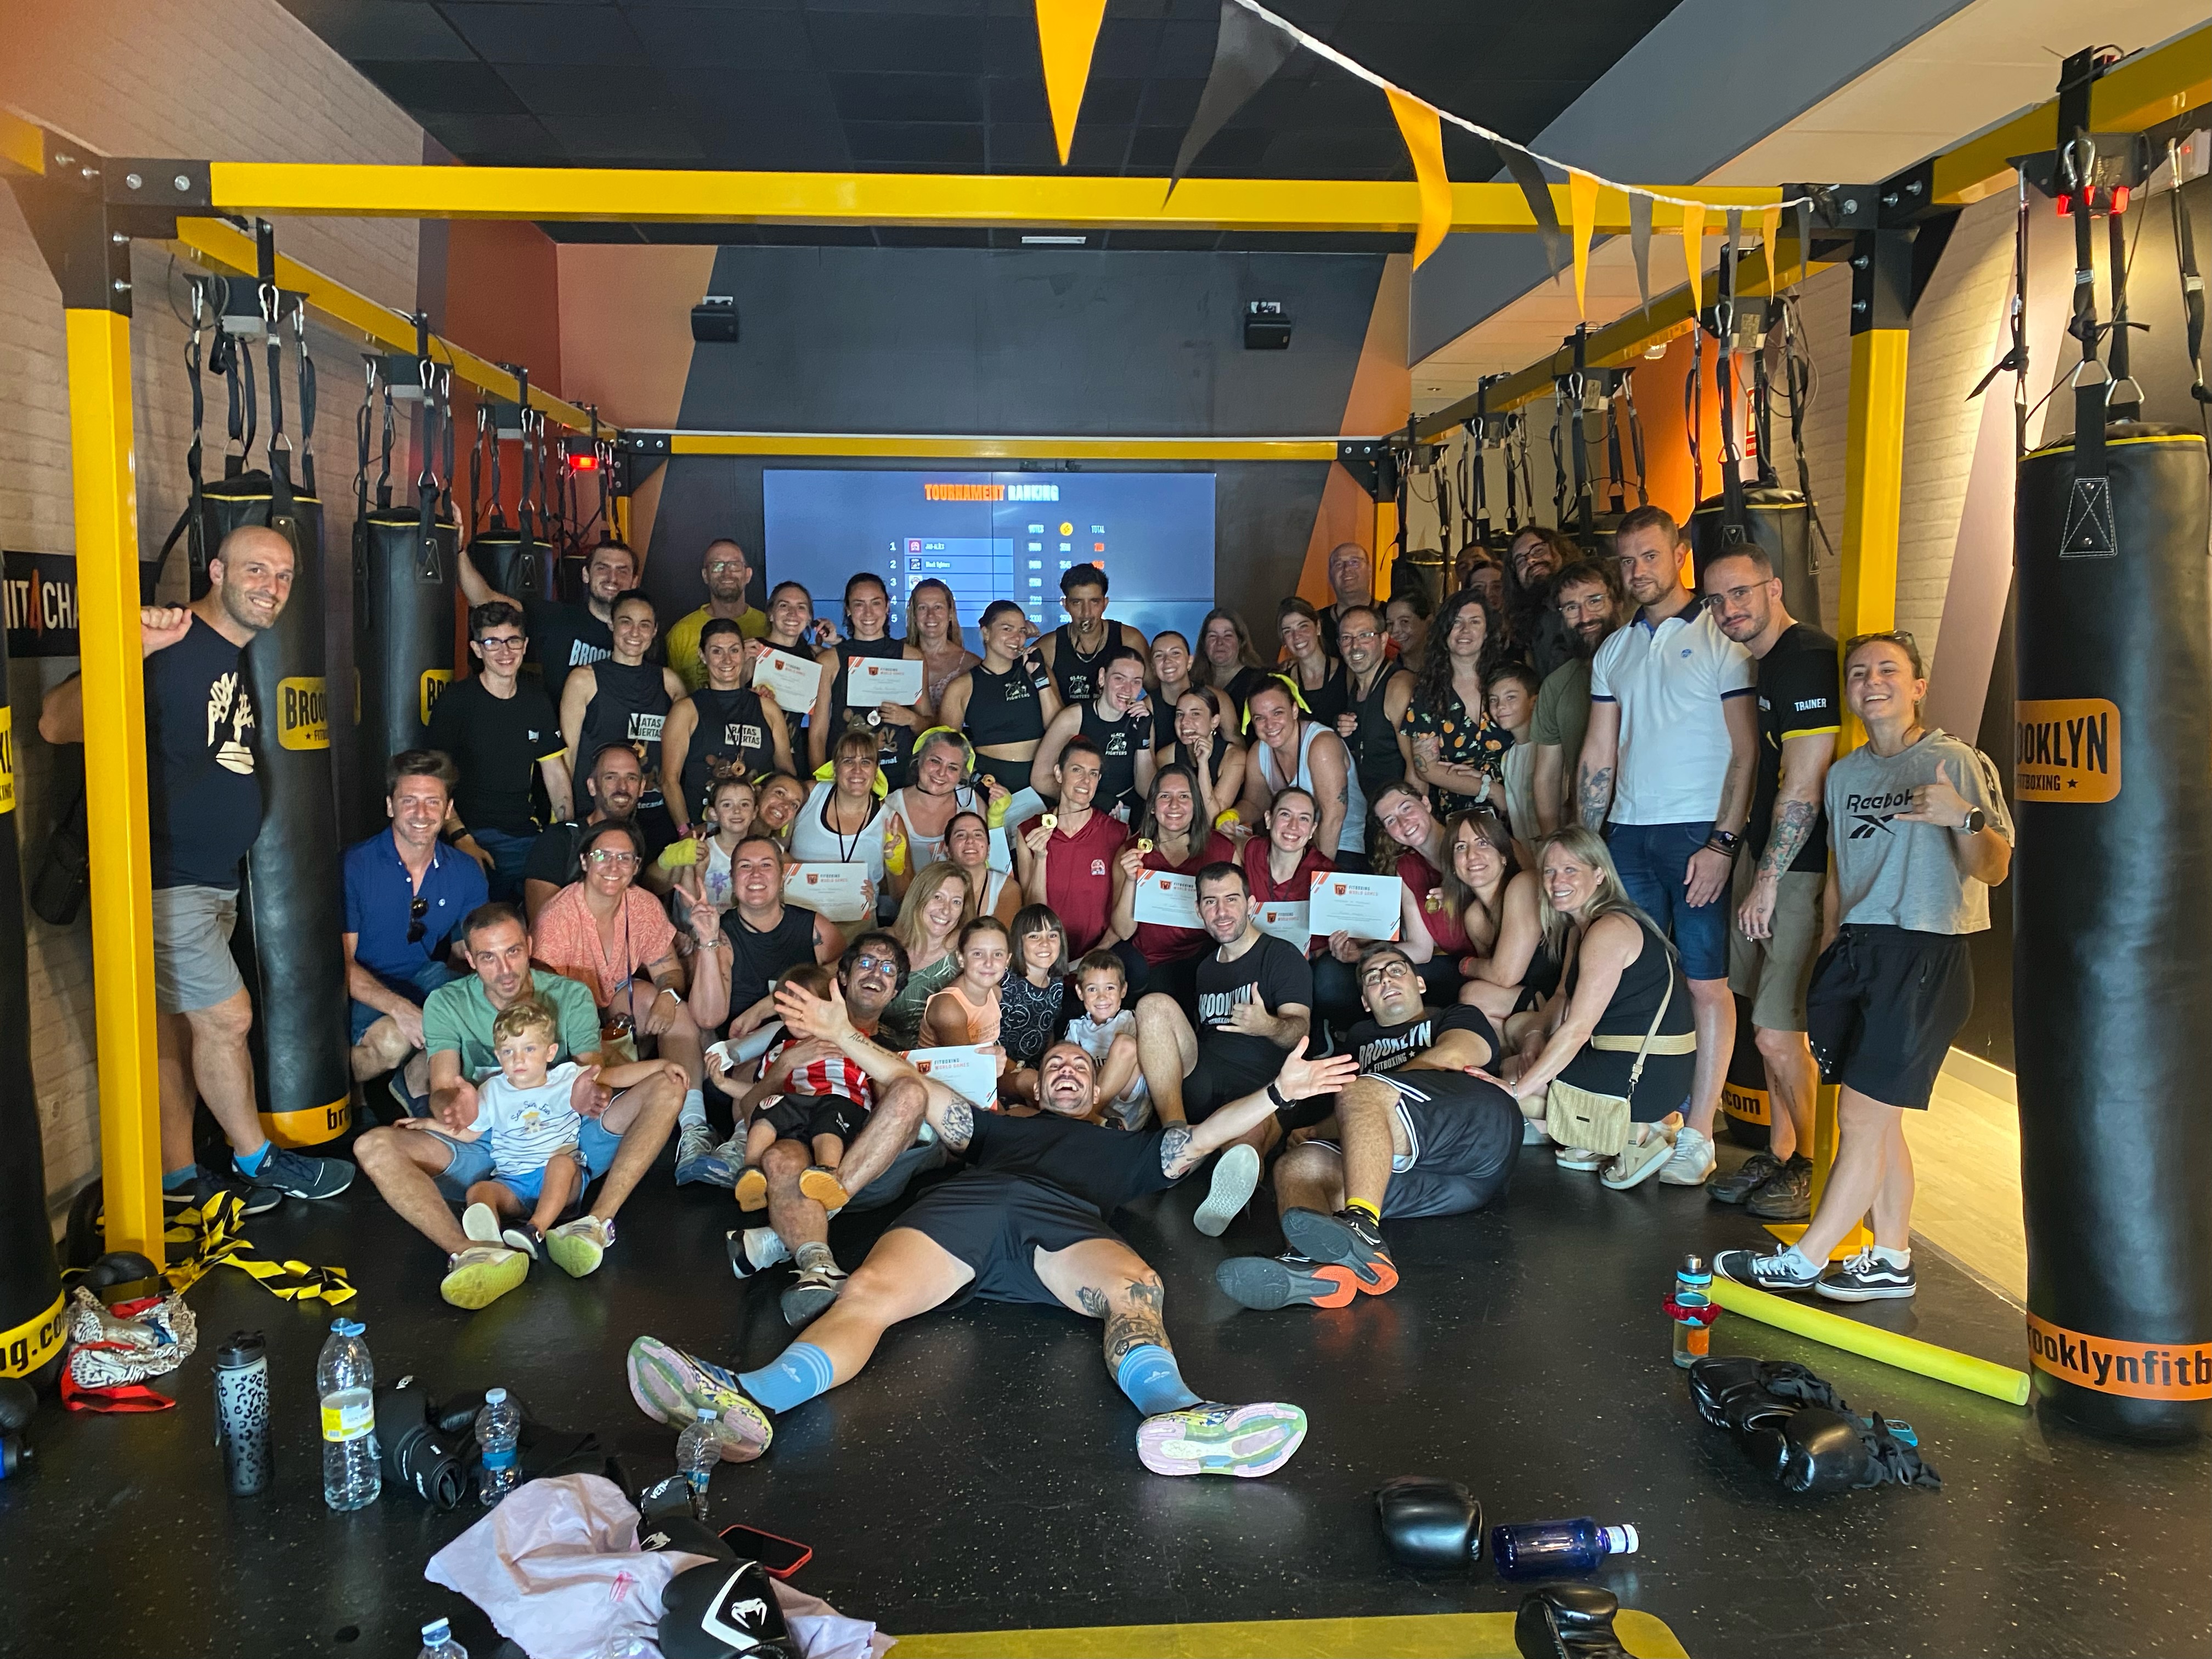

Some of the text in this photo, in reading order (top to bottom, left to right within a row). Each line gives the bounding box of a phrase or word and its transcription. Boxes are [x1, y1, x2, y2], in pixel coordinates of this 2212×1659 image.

[924, 484, 1059, 501] TOURNAMENT RANKING
[1091, 525, 1105, 534] TOTAL
[889, 542, 896, 551] 1
[890, 560, 896, 569] 2
[890, 578, 897, 586] 3
[890, 615, 898, 623] 5
[1794, 698, 1827, 712] TRAINER
[1358, 1020, 1432, 1074] BROOKLYN
[1374, 1052, 1408, 1073] FITBOXING
